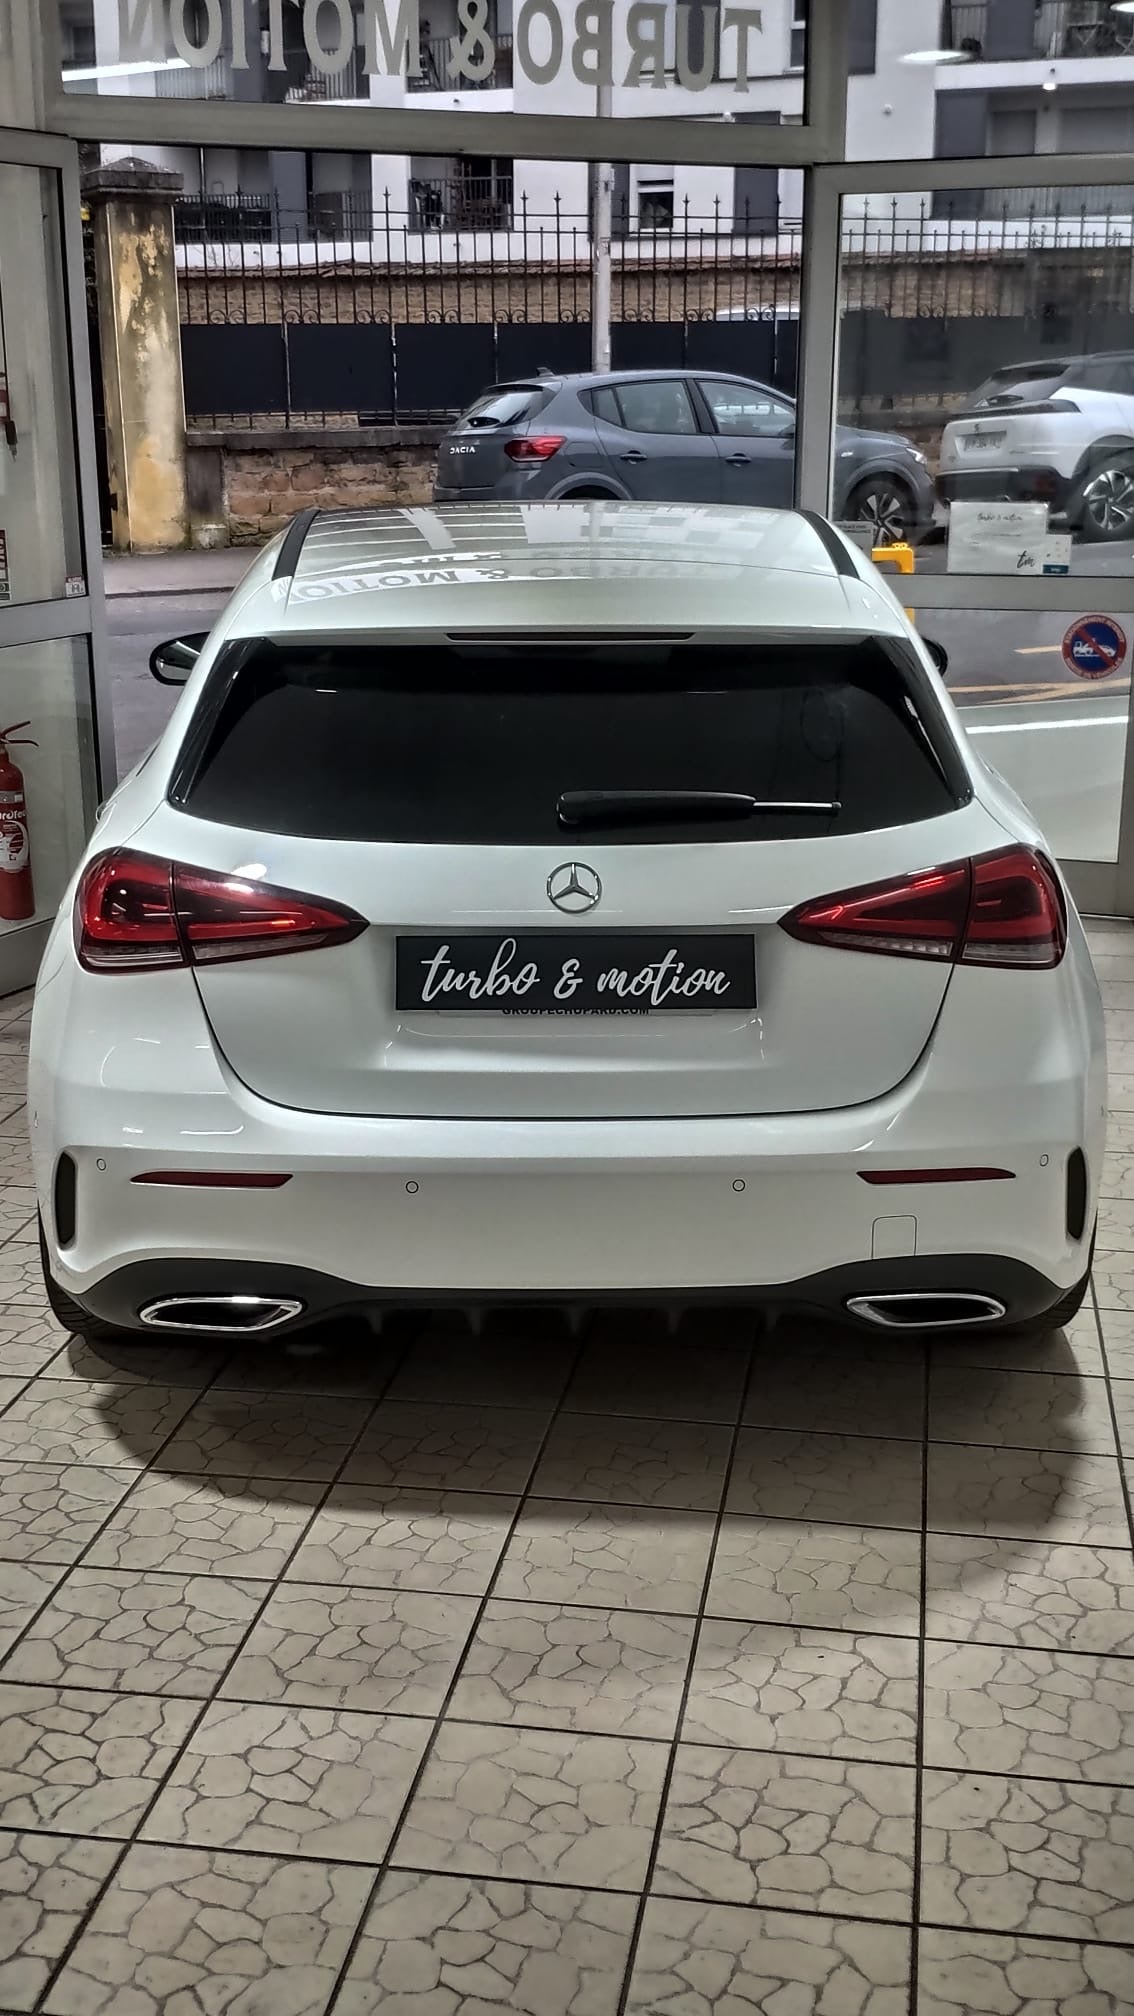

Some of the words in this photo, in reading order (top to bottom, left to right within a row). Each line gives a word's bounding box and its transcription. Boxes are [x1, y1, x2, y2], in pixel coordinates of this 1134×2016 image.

[449, 446, 476, 454] DACIA
[421, 938, 540, 1002] turbo
[554, 958, 583, 1000] &
[597, 949, 730, 1007] motion
